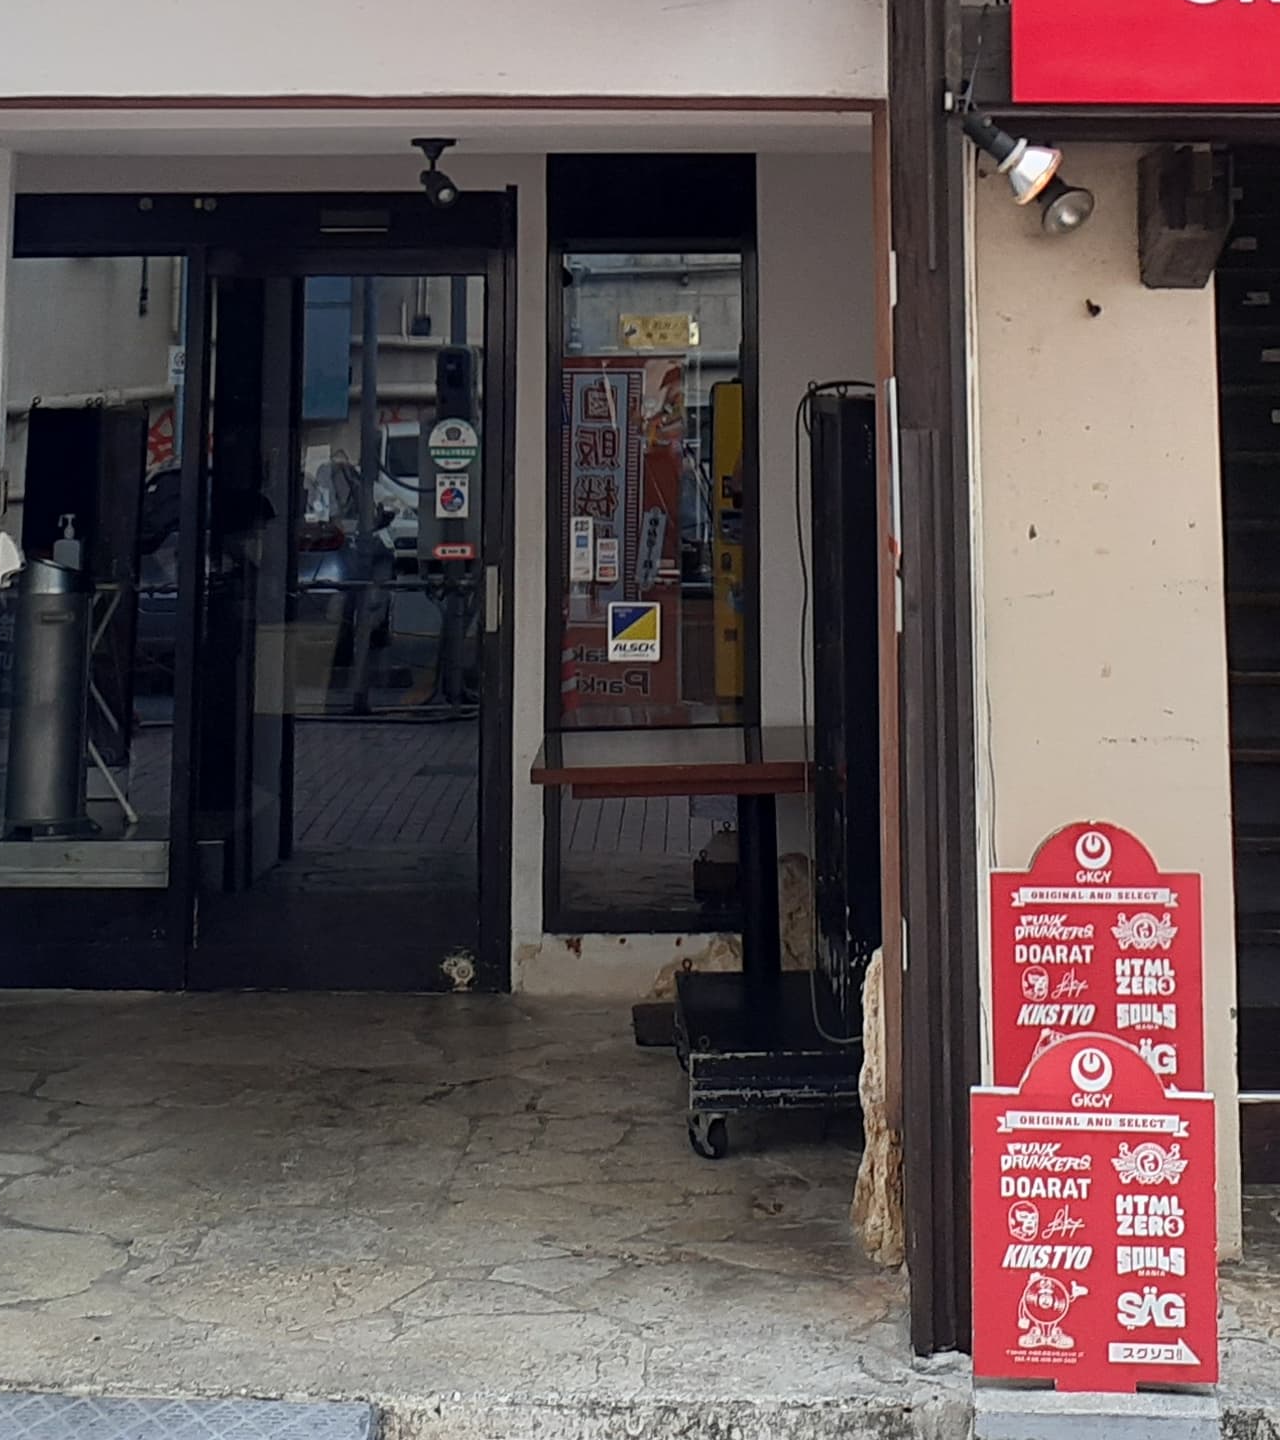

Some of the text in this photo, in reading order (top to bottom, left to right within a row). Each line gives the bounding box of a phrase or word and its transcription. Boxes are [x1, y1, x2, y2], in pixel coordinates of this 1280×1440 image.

[1076, 870, 1112, 884] GKCY
[1031, 890, 1159, 901] ORIGINAL AND SELECT
[1015, 944, 1094, 964] DOARAT
[1115, 959, 1175, 977] HTML
[1117, 1003, 1177, 1029] SOULS
[1071, 1093, 1113, 1108] GKCY
[1020, 1115, 1166, 1129] ORIGINAL AND SELECT
[1007, 1142, 1062, 1156] PUNK
[1001, 1154, 1092, 1172] DRUNKERS
[1001, 1176, 1091, 1199] DOARAT
[1116, 1195, 1184, 1216] HTML
[1117, 1246, 1186, 1277] SOULS
